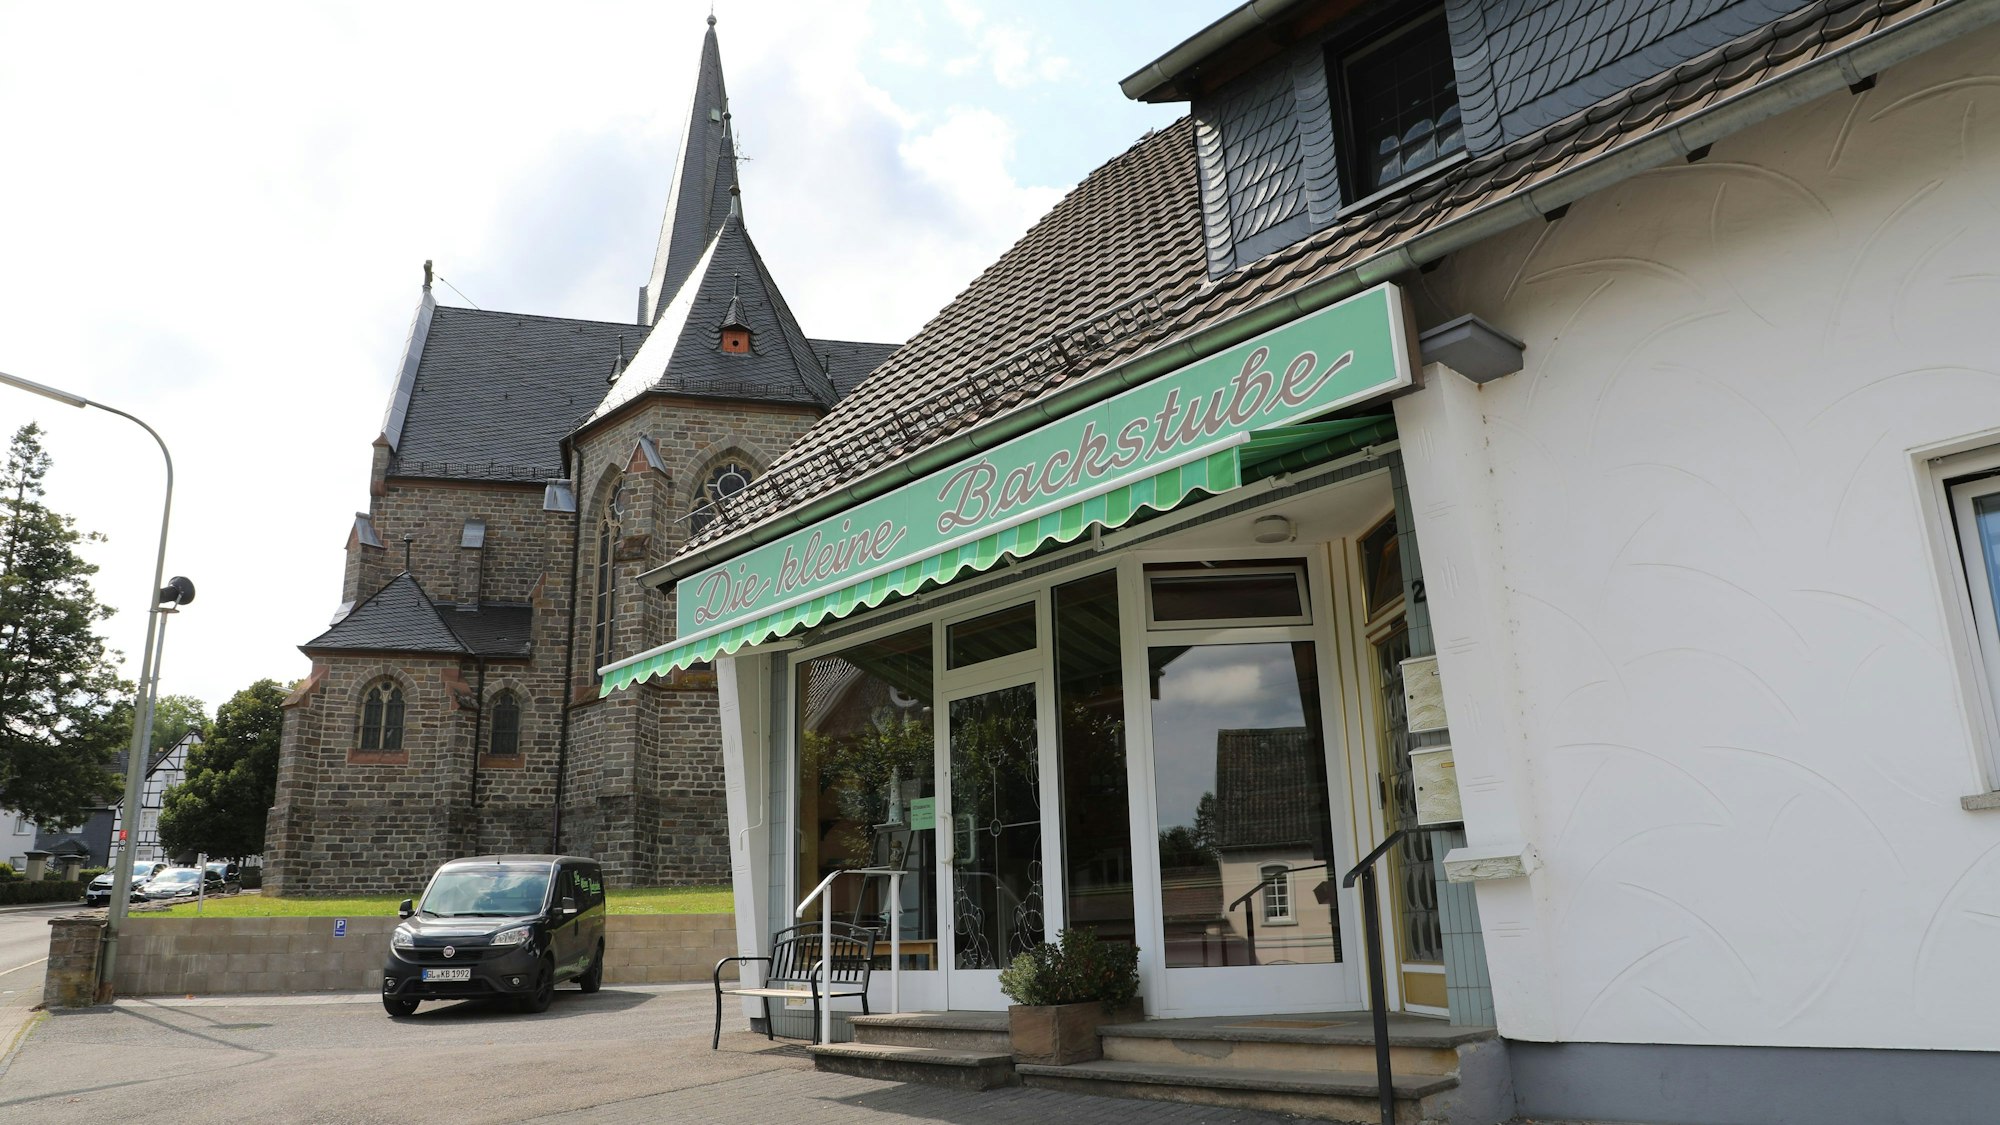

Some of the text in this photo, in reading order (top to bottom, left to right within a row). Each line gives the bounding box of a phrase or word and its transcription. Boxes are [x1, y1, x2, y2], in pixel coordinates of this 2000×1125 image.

[694, 345, 1354, 625] Die kleine Backstube
[1412, 580, 1426, 604] 2
[336, 920, 345, 929] P
[452, 970, 470, 978] 1992
